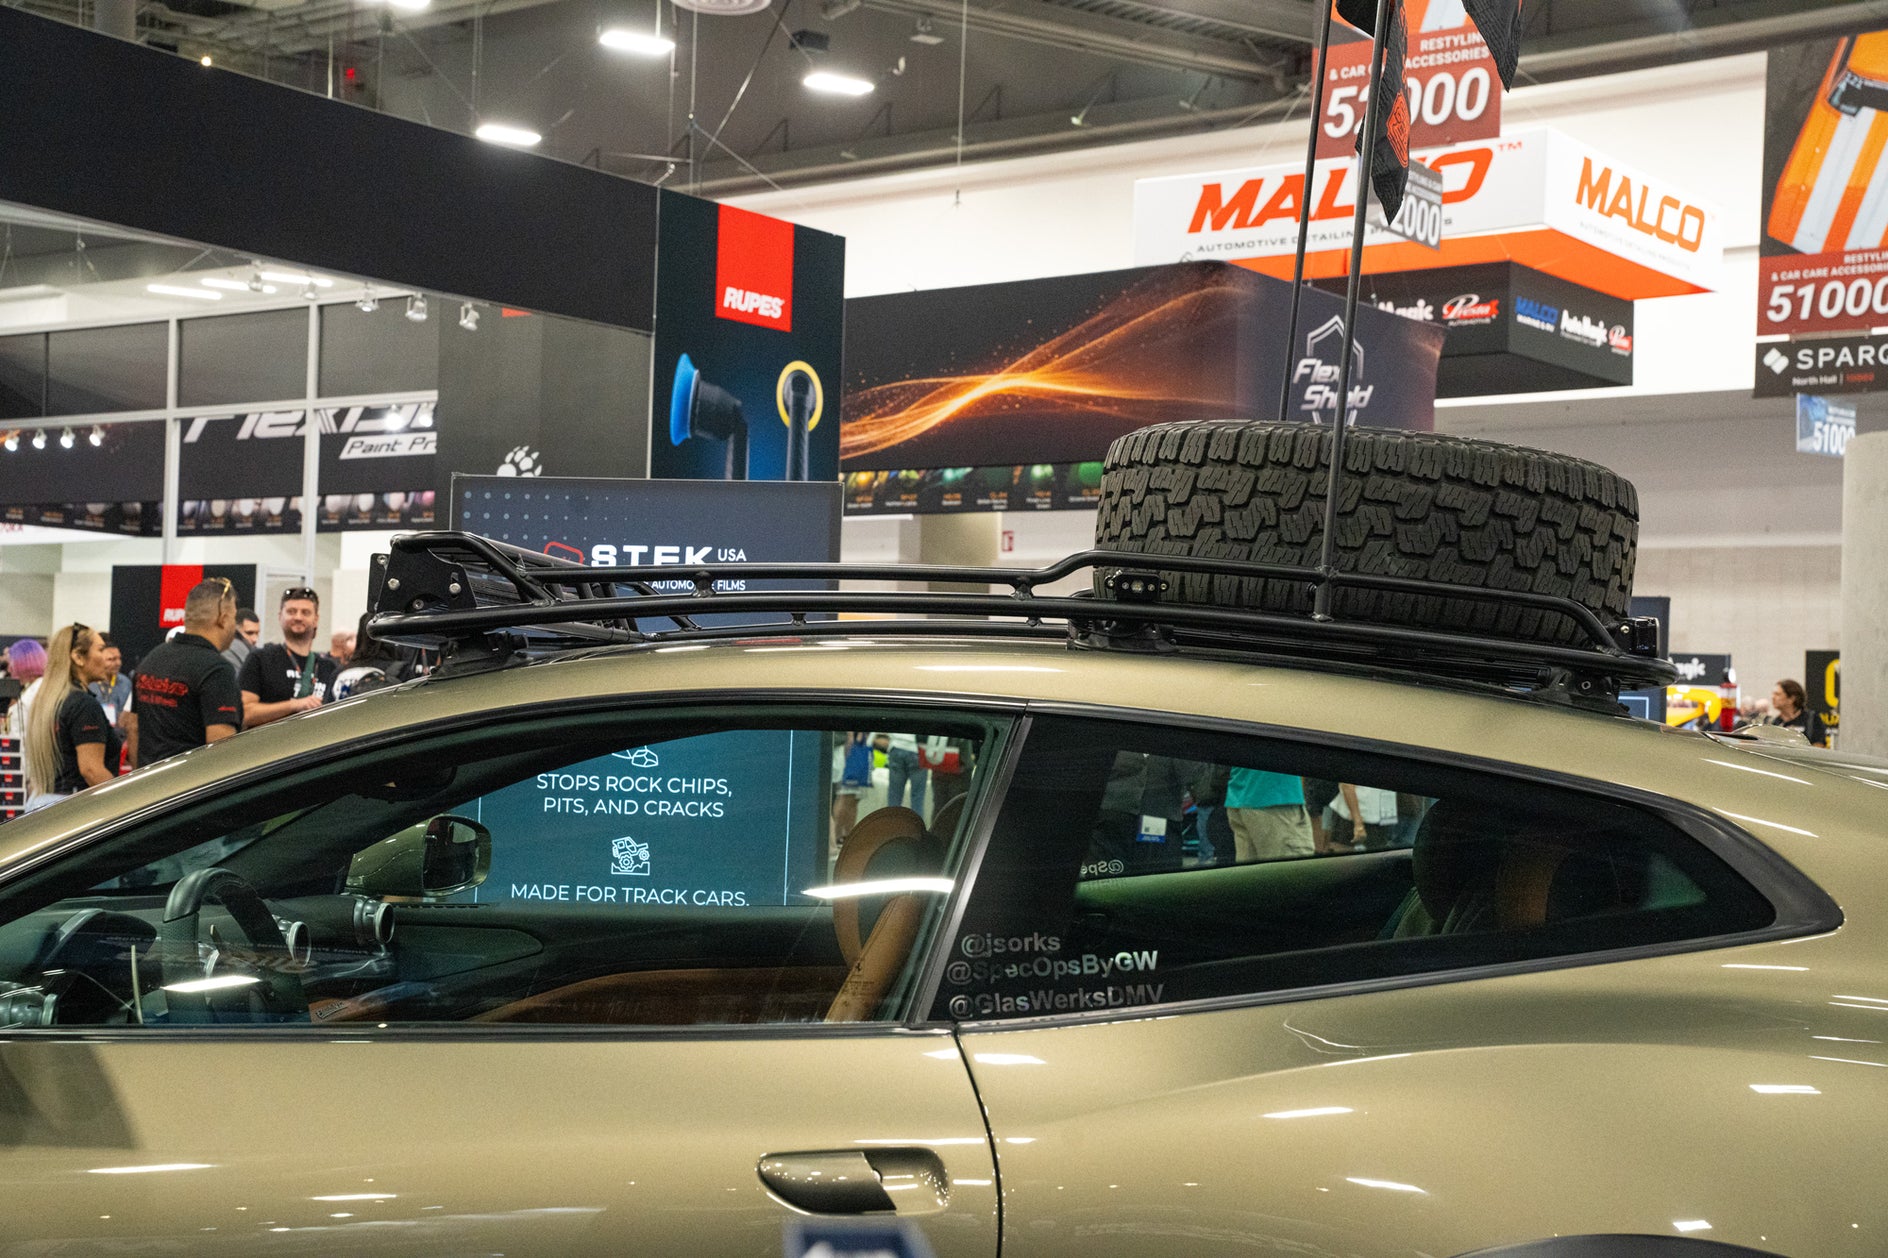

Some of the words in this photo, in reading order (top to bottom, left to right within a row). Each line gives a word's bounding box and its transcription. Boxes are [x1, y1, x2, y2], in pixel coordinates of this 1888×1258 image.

[1420, 31, 1485, 53] RESTYLIN
[1405, 46, 1490, 70] ACCESSORIES
[1340, 64, 1367, 80] CAR
[1187, 147, 1494, 234] MALO
[1575, 156, 1706, 253] MALCO
[1197, 236, 1287, 254] AUTOMOTIVE
[1291, 229, 1355, 246] DTAILIN
[1780, 269, 1801, 281] CAR
[1802, 266, 1829, 279] CARE
[723, 286, 785, 319] RUPES
[1293, 358, 1352, 384] Flex
[1300, 384, 1374, 410] Shld
[348, 437, 403, 455] Paint
[409, 435, 437, 452] Pr
[591, 544, 713, 567] STEK
[717, 548, 747, 562] USA
[651, 579, 714, 592] AUTOMO
[717, 579, 747, 592] FILMS
[537, 774, 600, 791] STOPS
[606, 776, 662, 793] ROCK
[667, 777, 732, 798] CHIPS,
[544, 797, 589, 816] PITS,
[594, 799, 639, 816] AND
[644, 801, 724, 818] CRACKS
[511, 884, 570, 901] MADE
[576, 886, 616, 903] FOR
[622, 887, 688, 905] TRACK
[693, 890, 750, 907] CARS.
[961, 932, 1061, 959] @jsorks
[946, 950, 1159, 985] @SpecOpsByGW
[947, 983, 1165, 1019] @GlasWerksDMV
